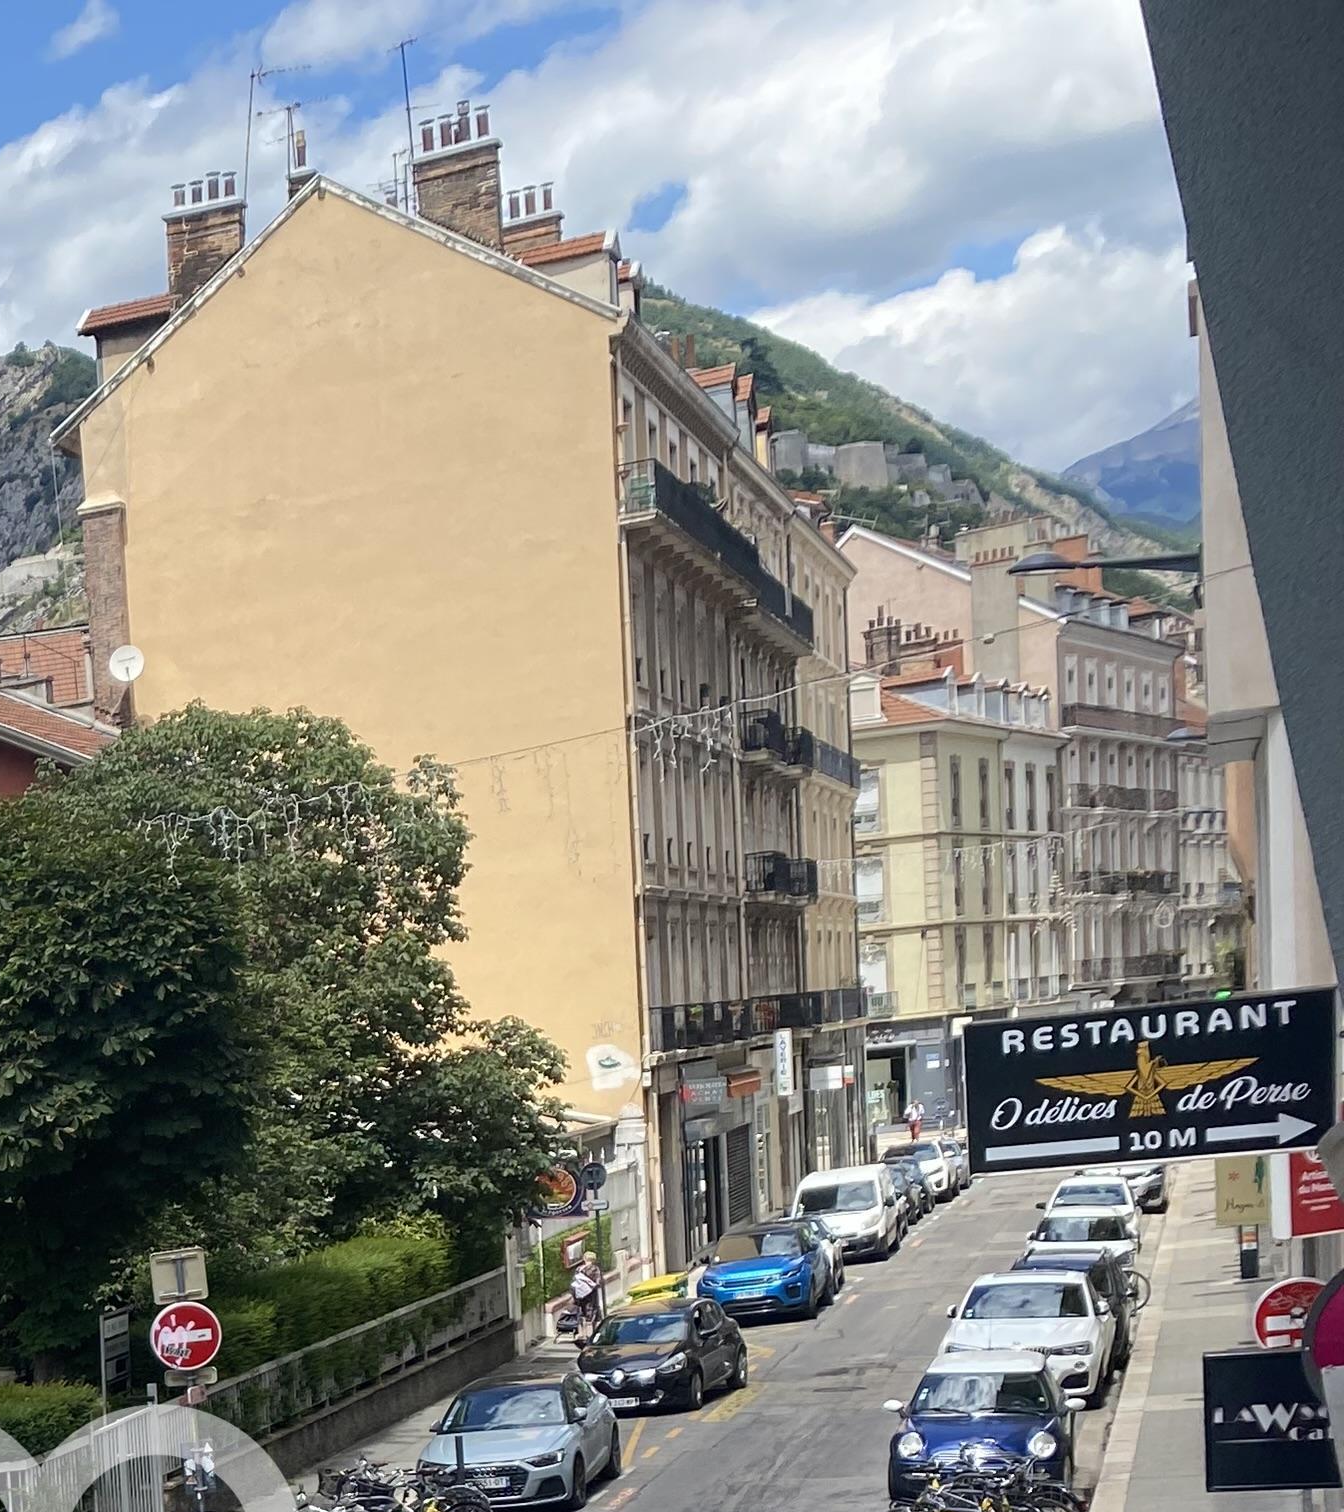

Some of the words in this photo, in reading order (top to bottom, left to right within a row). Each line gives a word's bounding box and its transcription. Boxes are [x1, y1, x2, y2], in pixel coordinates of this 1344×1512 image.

[1002, 1000, 1298, 1055] RESTAURANT
[991, 1097, 1022, 1131] O
[1024, 1095, 1118, 1127] délices
[1178, 1083, 1218, 1113] de
[1219, 1075, 1311, 1112] Perse
[1128, 1130, 1161, 1152] 10
[1168, 1126, 1198, 1149] M
